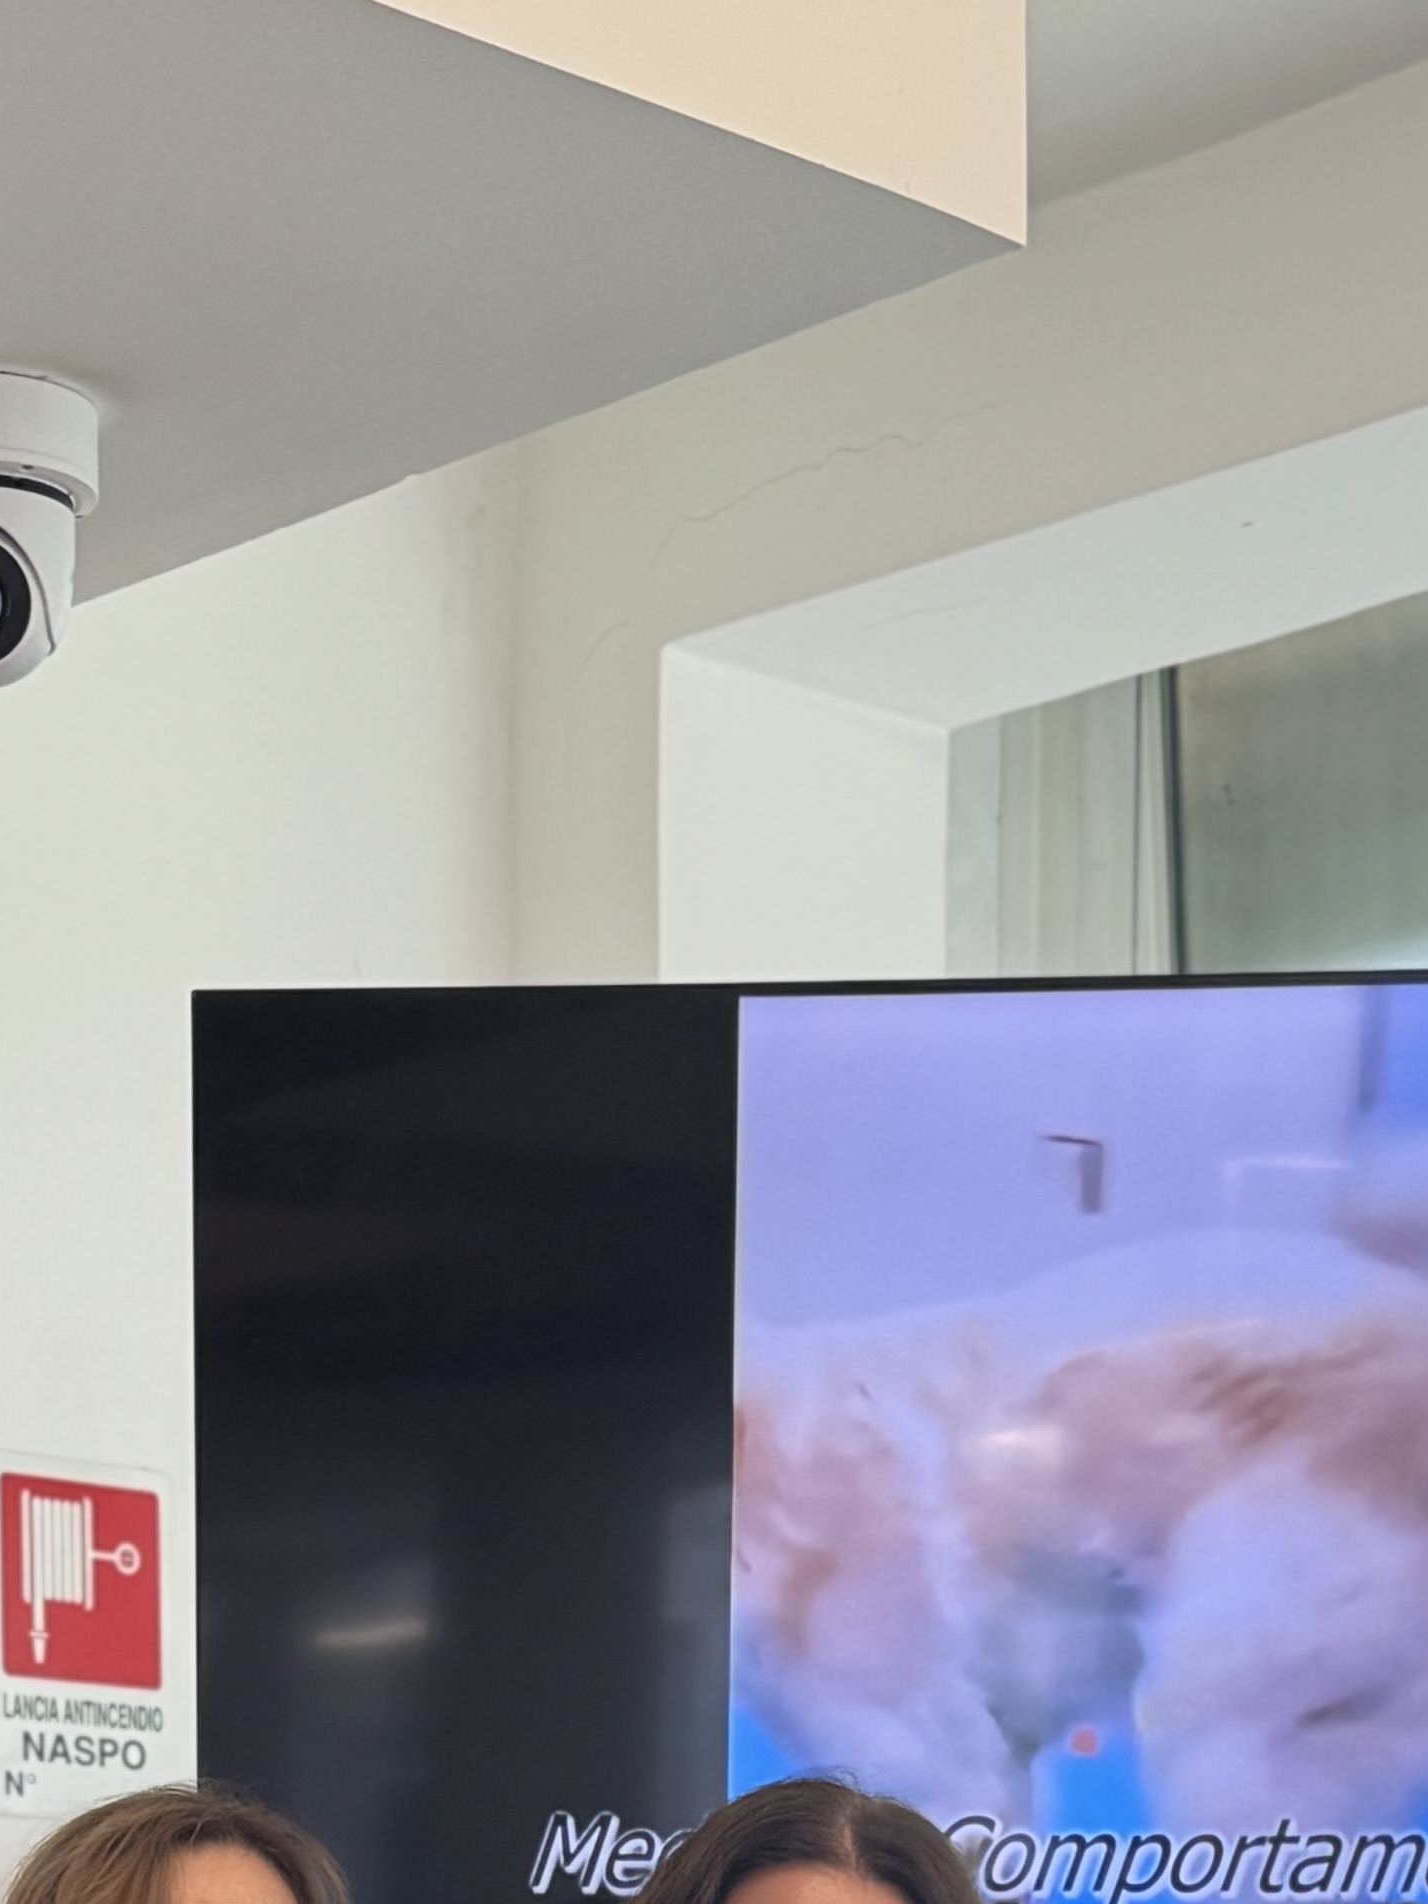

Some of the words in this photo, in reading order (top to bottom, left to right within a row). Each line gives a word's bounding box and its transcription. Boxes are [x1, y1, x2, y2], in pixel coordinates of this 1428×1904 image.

[3, 1692, 58, 1721] LANCIA
[63, 1698, 163, 1733] ANTINCENDIO
[23, 1730, 147, 1771] NASPO
